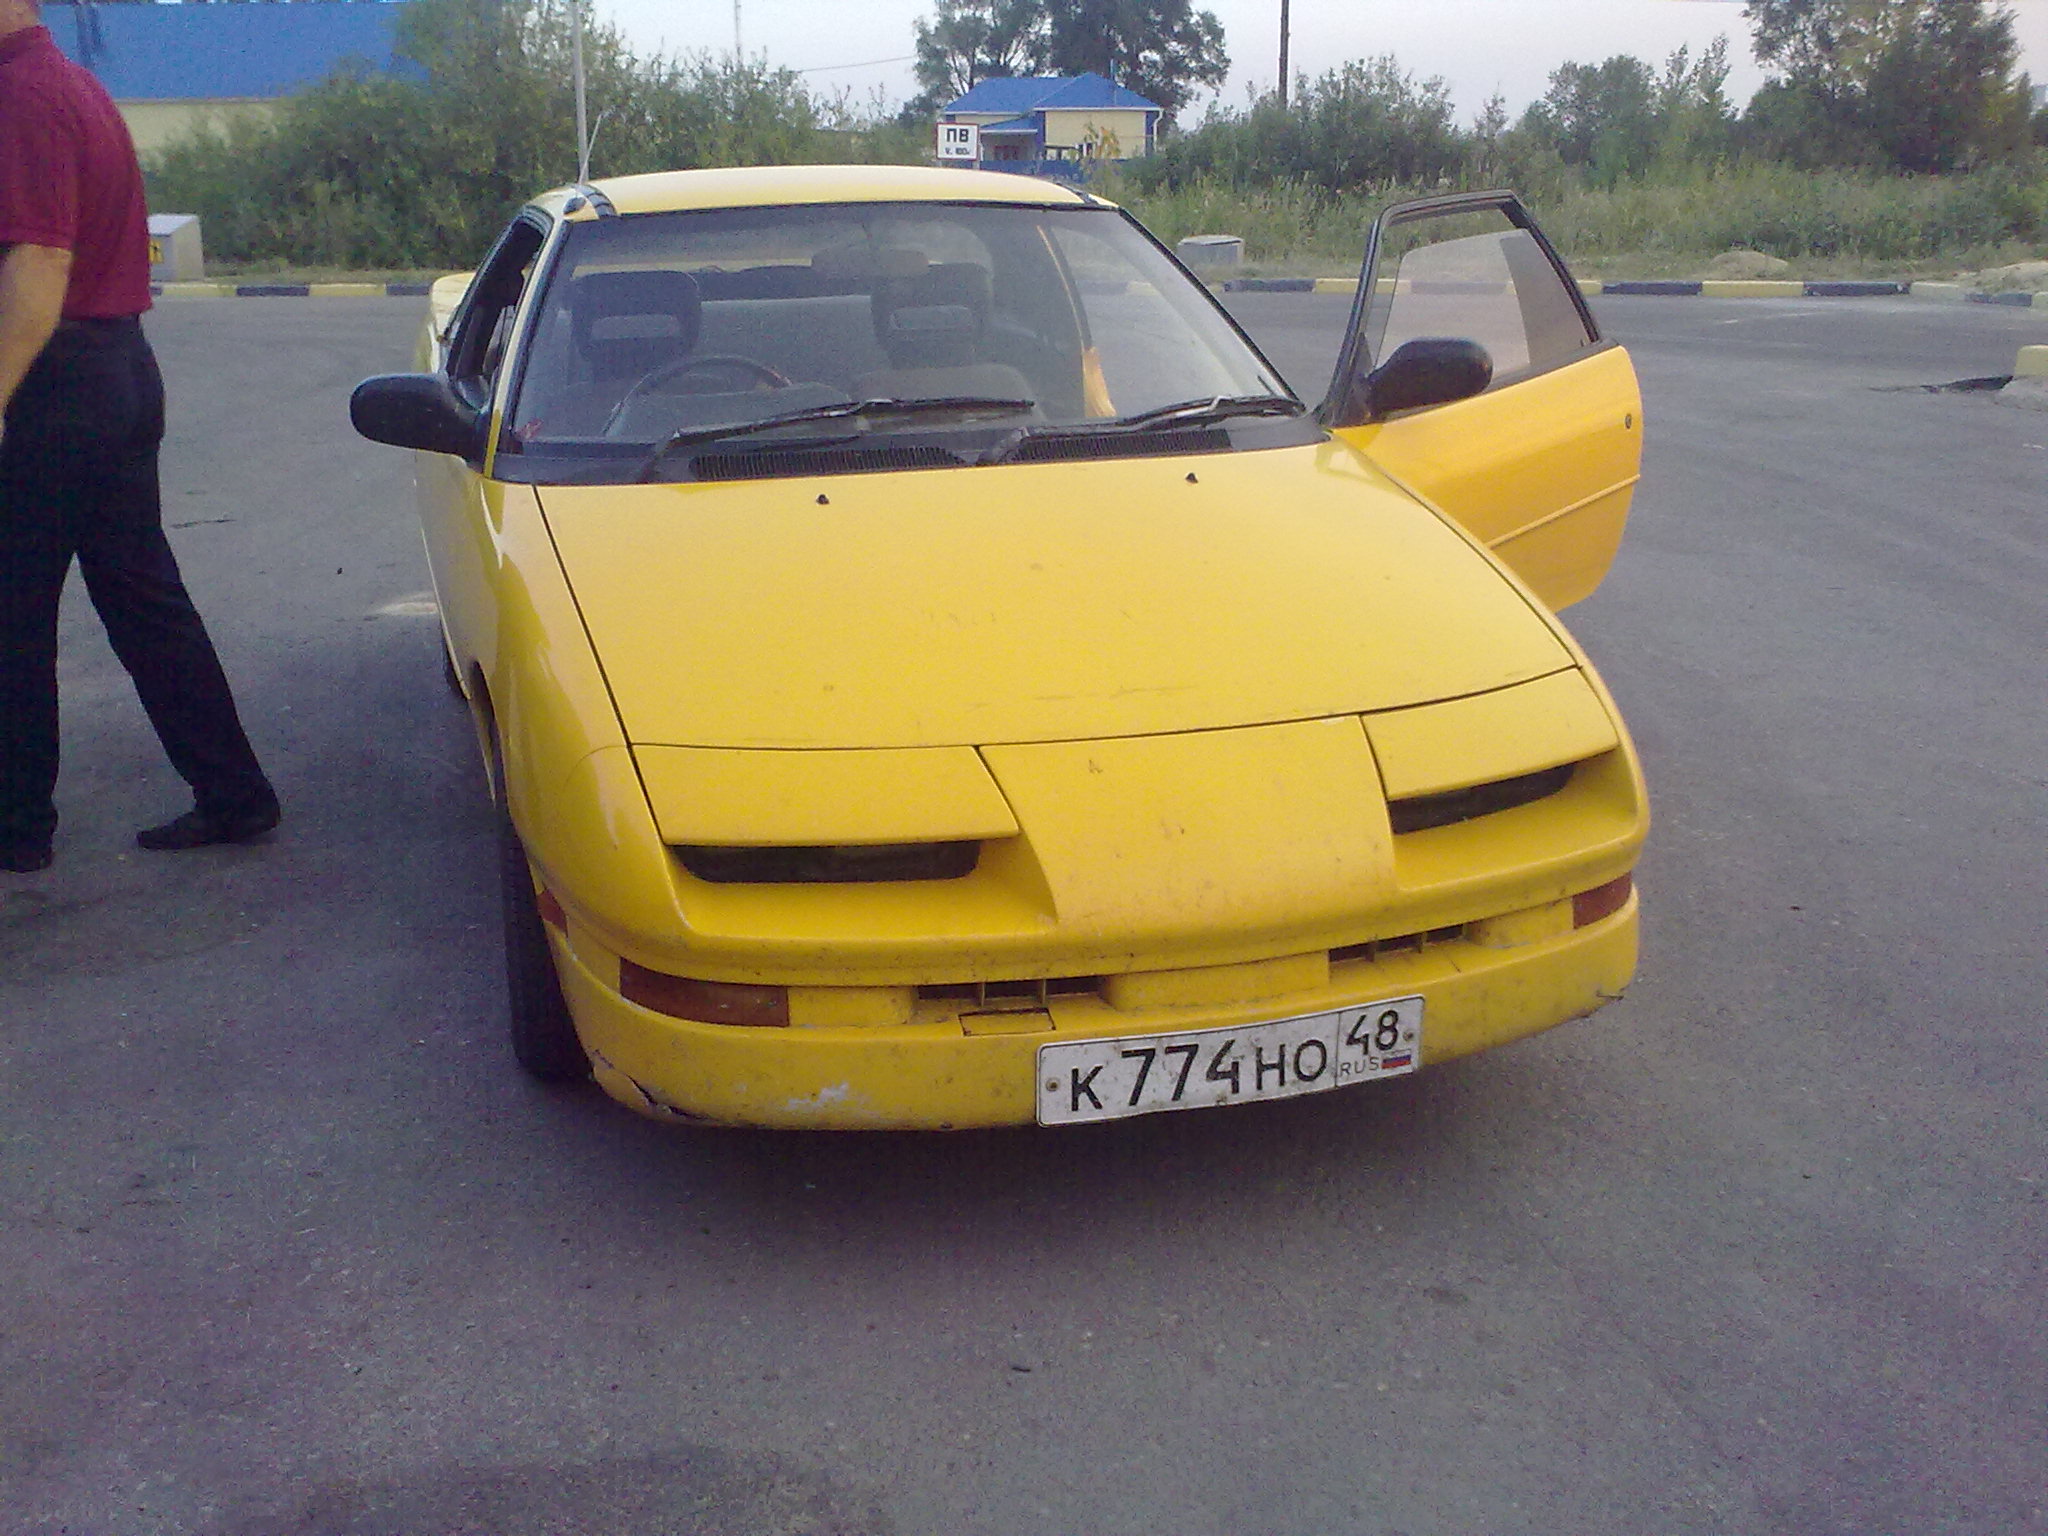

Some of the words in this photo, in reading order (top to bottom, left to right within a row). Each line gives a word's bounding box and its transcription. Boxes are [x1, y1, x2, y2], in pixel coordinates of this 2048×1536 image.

[947, 128, 969, 143] ПВ
[1346, 1009, 1400, 1056] 48
[1340, 1057, 1380, 1077] RUS
